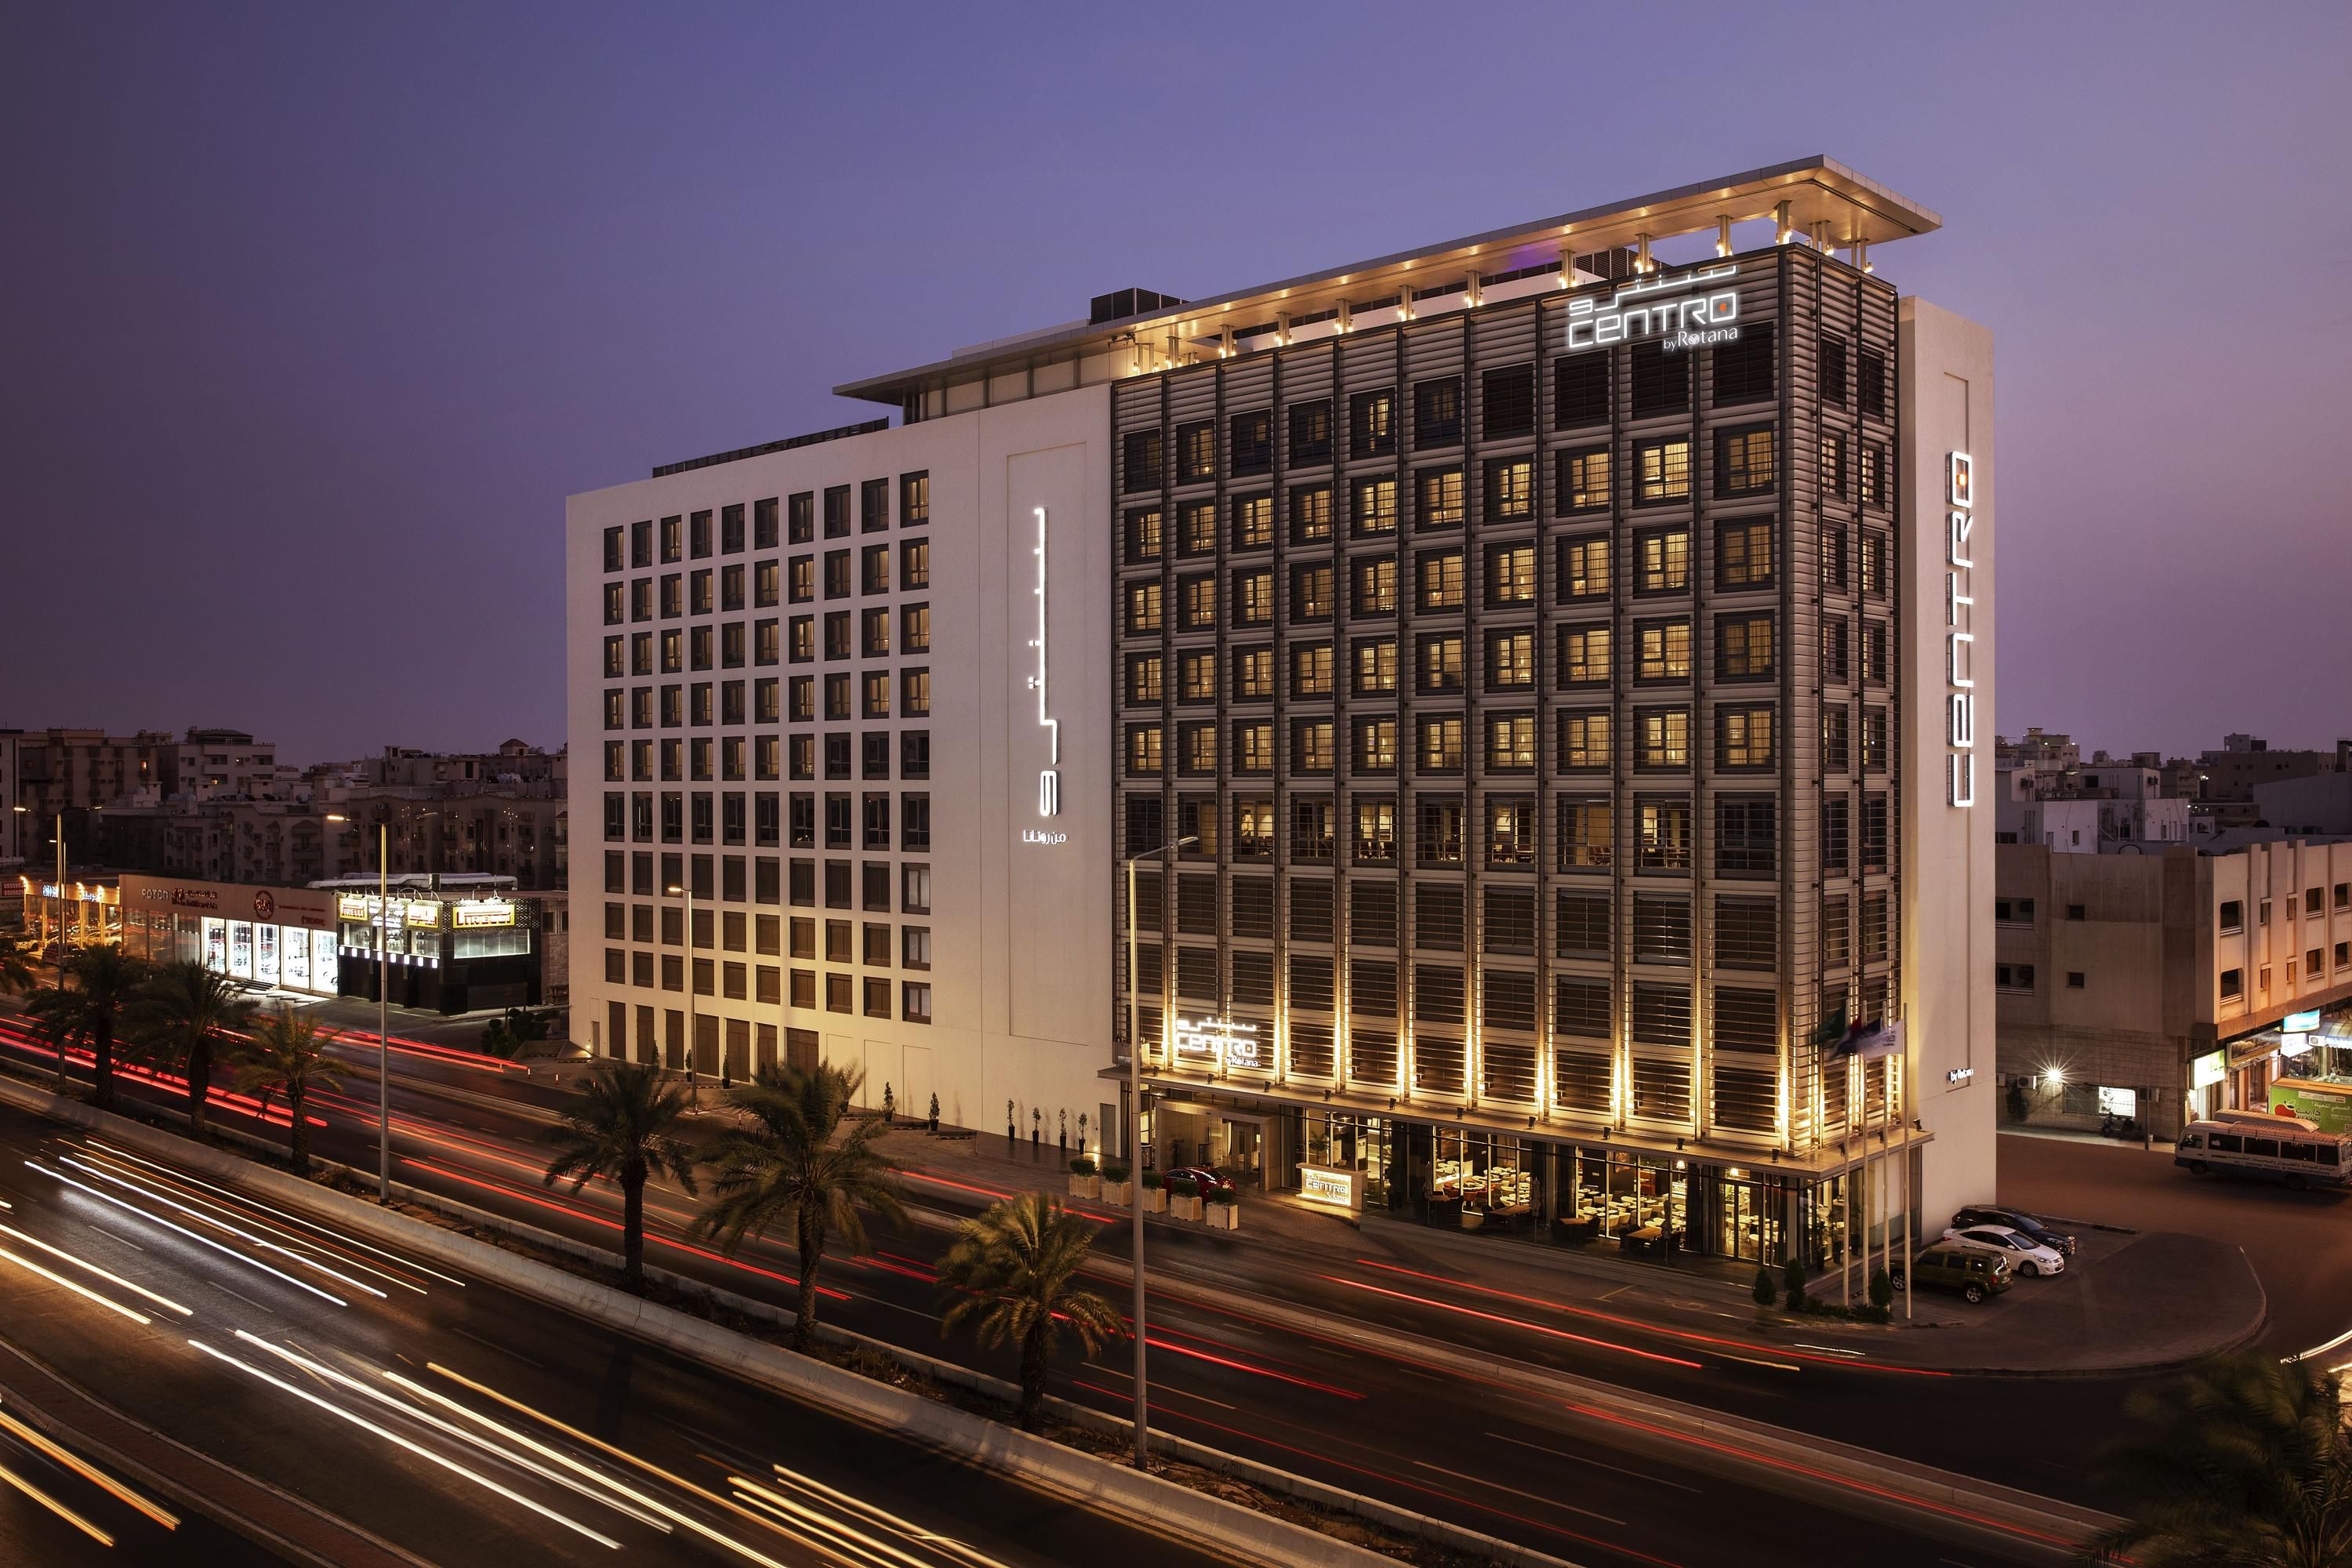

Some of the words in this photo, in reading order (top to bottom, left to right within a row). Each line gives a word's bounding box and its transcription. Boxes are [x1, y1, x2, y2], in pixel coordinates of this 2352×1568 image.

[1664, 339, 1677, 352] by
[1678, 328, 1738, 347] Rotana
[1022, 829, 1051, 845] روتانا
[1051, 831, 1067, 845] من
[456, 911, 511, 926] PIRELLI
[1950, 1071, 1957, 1084] by
